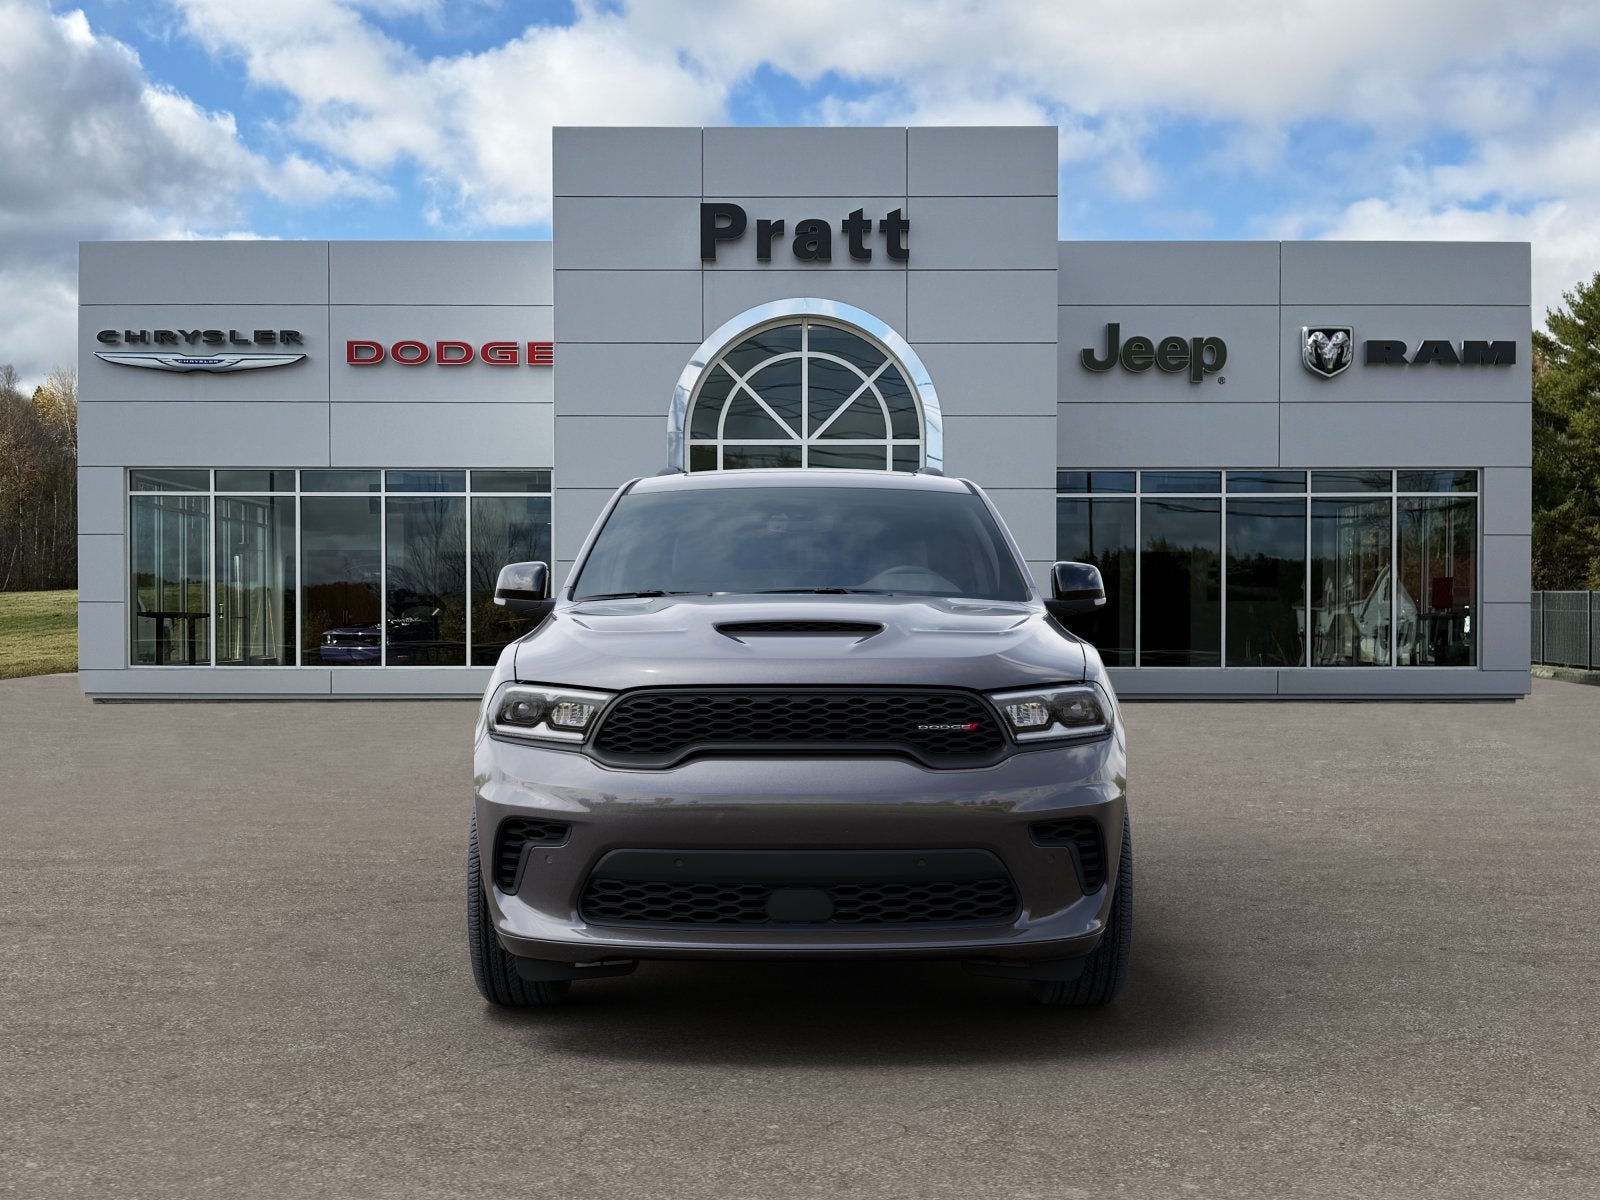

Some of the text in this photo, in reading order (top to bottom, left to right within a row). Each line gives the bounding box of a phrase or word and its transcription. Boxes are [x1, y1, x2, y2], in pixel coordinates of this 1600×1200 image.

[701, 203, 910, 262] Pratt
[96, 329, 304, 345] CHRYSLER
[346, 340, 553, 365] DODGE
[1081, 322, 1227, 383] Jeep
[1363, 339, 1516, 366] RAM
